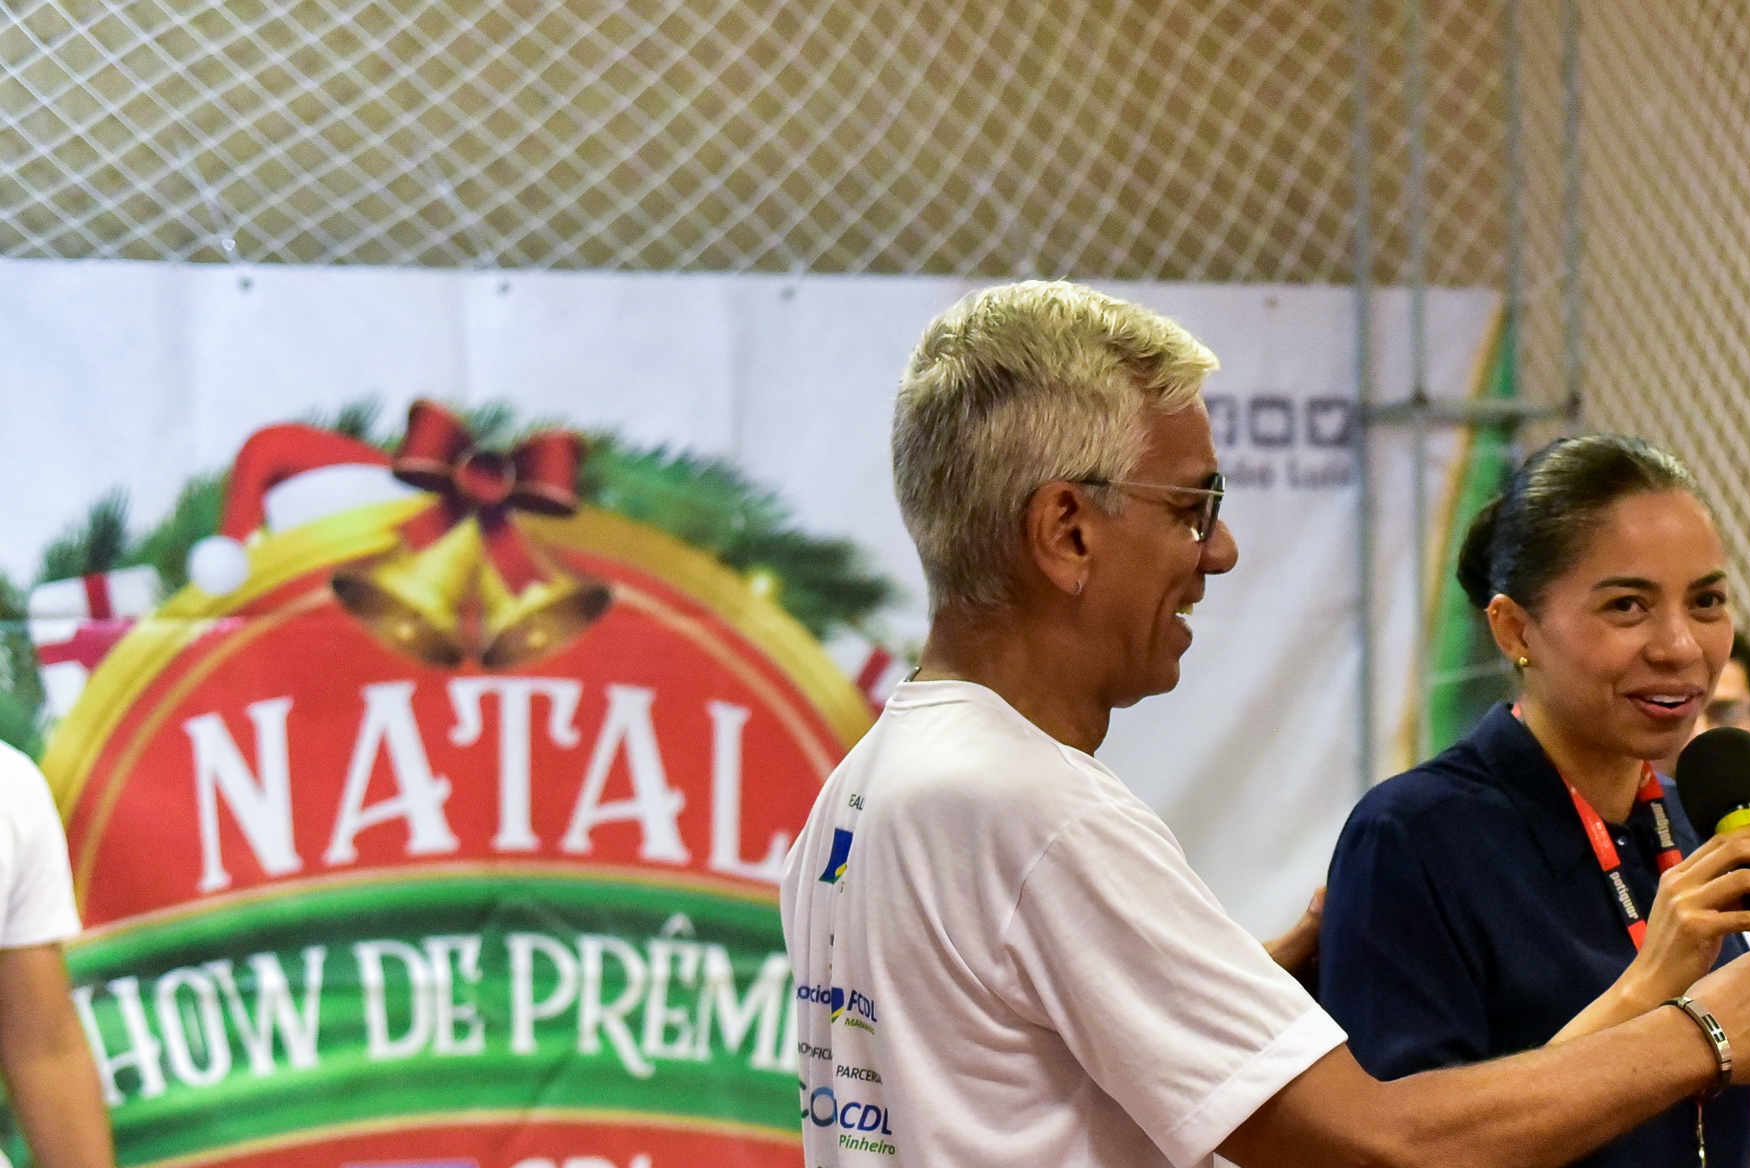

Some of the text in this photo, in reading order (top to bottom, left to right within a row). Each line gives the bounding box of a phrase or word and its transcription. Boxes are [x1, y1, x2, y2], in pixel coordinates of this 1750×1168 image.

[183, 676, 788, 893] NATAL
[1609, 871, 1639, 919] potiguar
[73, 943, 327, 1106] HOW
[352, 933, 487, 1062] DE
[846, 989, 878, 1023] FCDL
[839, 1101, 893, 1135] CDL
[838, 1134, 896, 1156] Pinheiro
